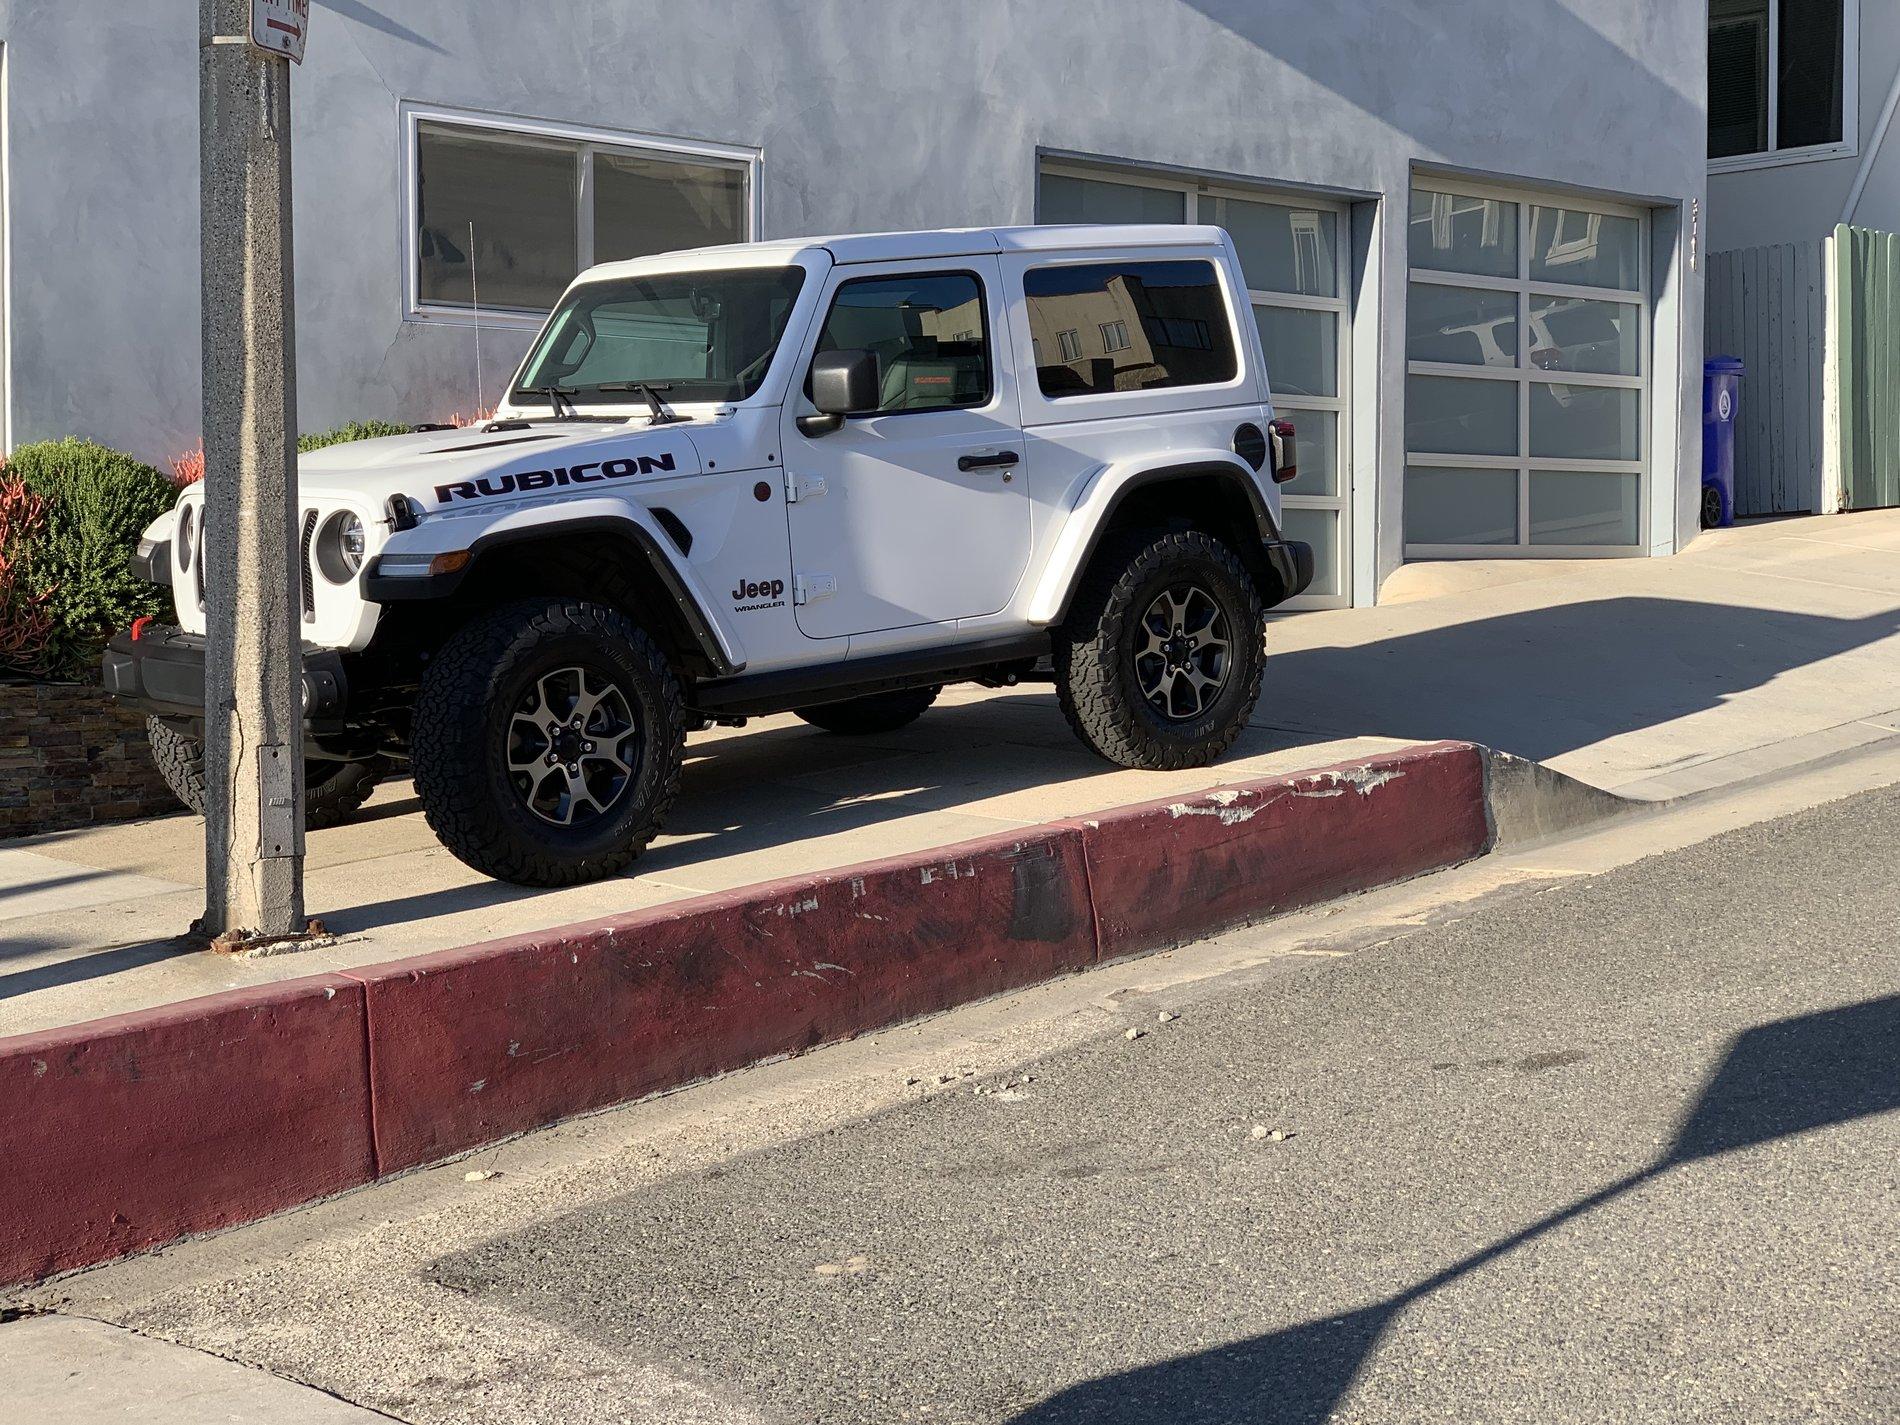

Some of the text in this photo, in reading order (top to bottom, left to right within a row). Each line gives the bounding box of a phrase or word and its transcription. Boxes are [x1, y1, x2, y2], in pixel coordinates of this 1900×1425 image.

[433, 452, 676, 503] RUBICON
[731, 578, 784, 600] Jeep
[734, 601, 785, 613] WRANGLER
